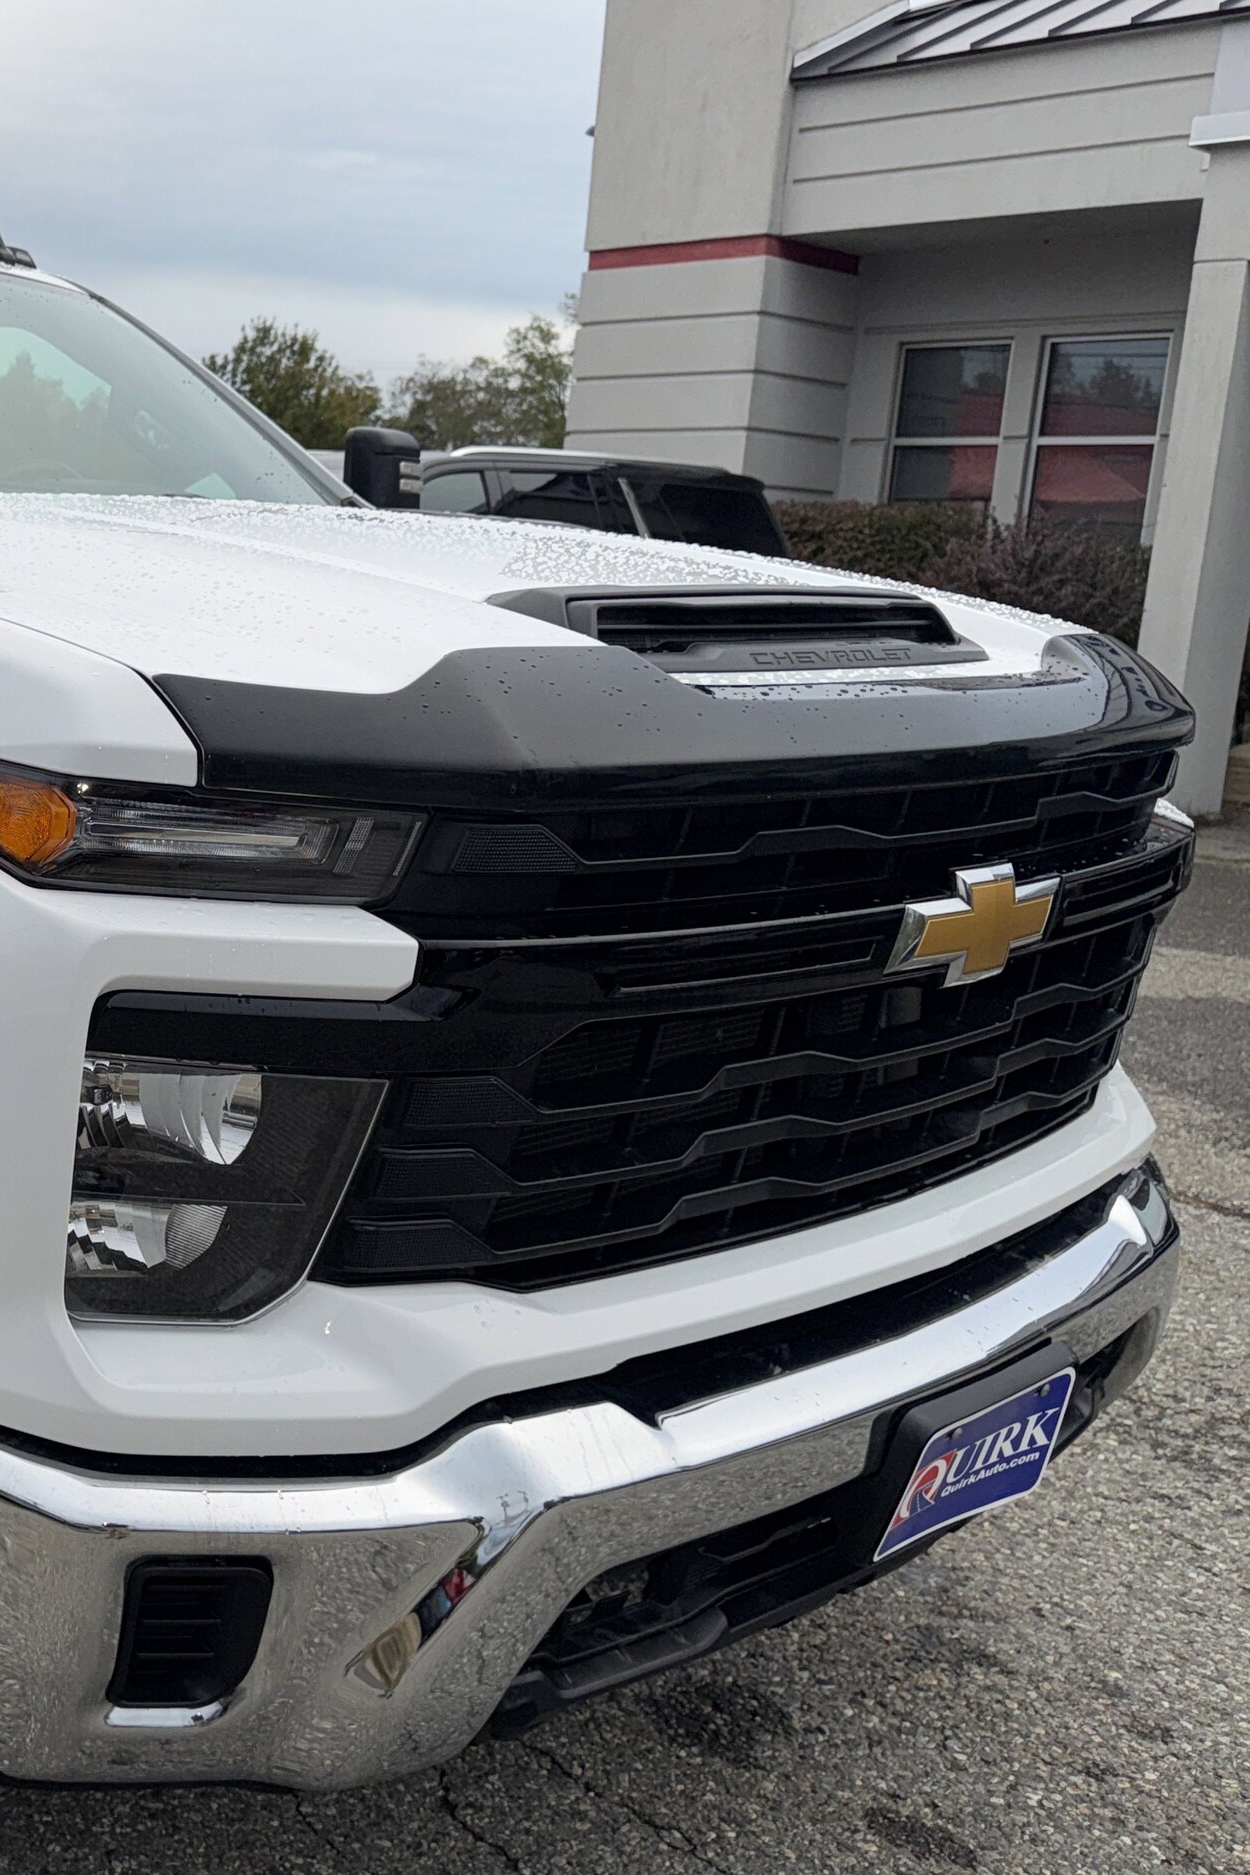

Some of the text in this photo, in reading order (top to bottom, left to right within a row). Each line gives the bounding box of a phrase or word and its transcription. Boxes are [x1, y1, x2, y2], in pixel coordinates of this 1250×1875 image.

[749, 647, 912, 666] CHEVROLET
[899, 1407, 1061, 1519] QUIRK
[940, 1451, 1040, 1498] QuirkAuto.com
